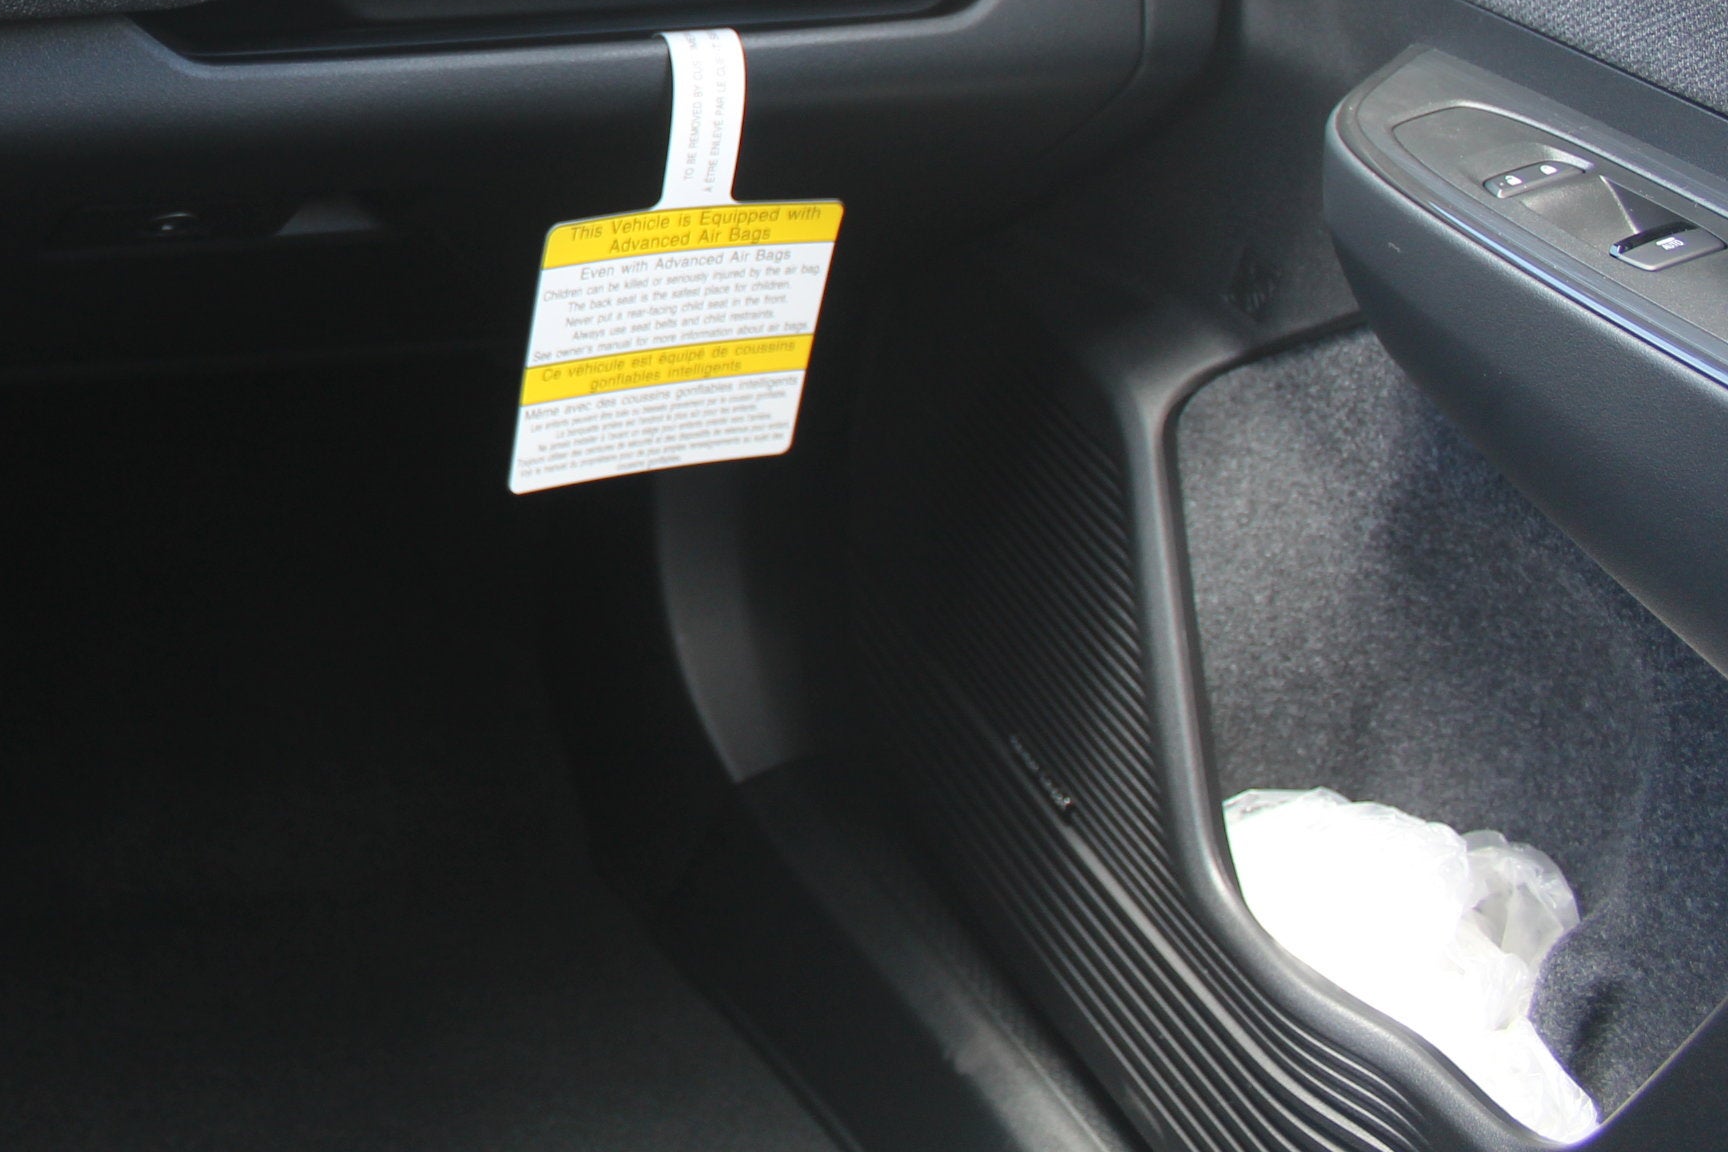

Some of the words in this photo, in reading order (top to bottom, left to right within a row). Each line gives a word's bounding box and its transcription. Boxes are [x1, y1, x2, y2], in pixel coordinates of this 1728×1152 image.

[715, 96, 725, 116] PAR
[688, 102, 702, 148] REMOVED
[686, 152, 697, 164] BE
[683, 167, 695, 181] TO
[571, 225, 602, 242] This
[611, 217, 670, 235] Vehicle
[678, 214, 691, 226] is
[699, 208, 780, 227] Equipped
[787, 206, 822, 221] with
[609, 233, 691, 254] Advanced
[698, 228, 721, 244] Air
[728, 226, 771, 245] Bags
[580, 267, 614, 281] Even
[622, 259, 648, 274] with
[654, 252, 724, 271] Advanced
[729, 250, 750, 263] Air
[755, 248, 791, 263] Bags
[543, 286, 583, 301] Children
[541, 368, 562, 382] Ce
[632, 355, 652, 367] est
[711, 345, 728, 358] de
[735, 341, 796, 356] coussins
[668, 360, 742, 379] intelligents
